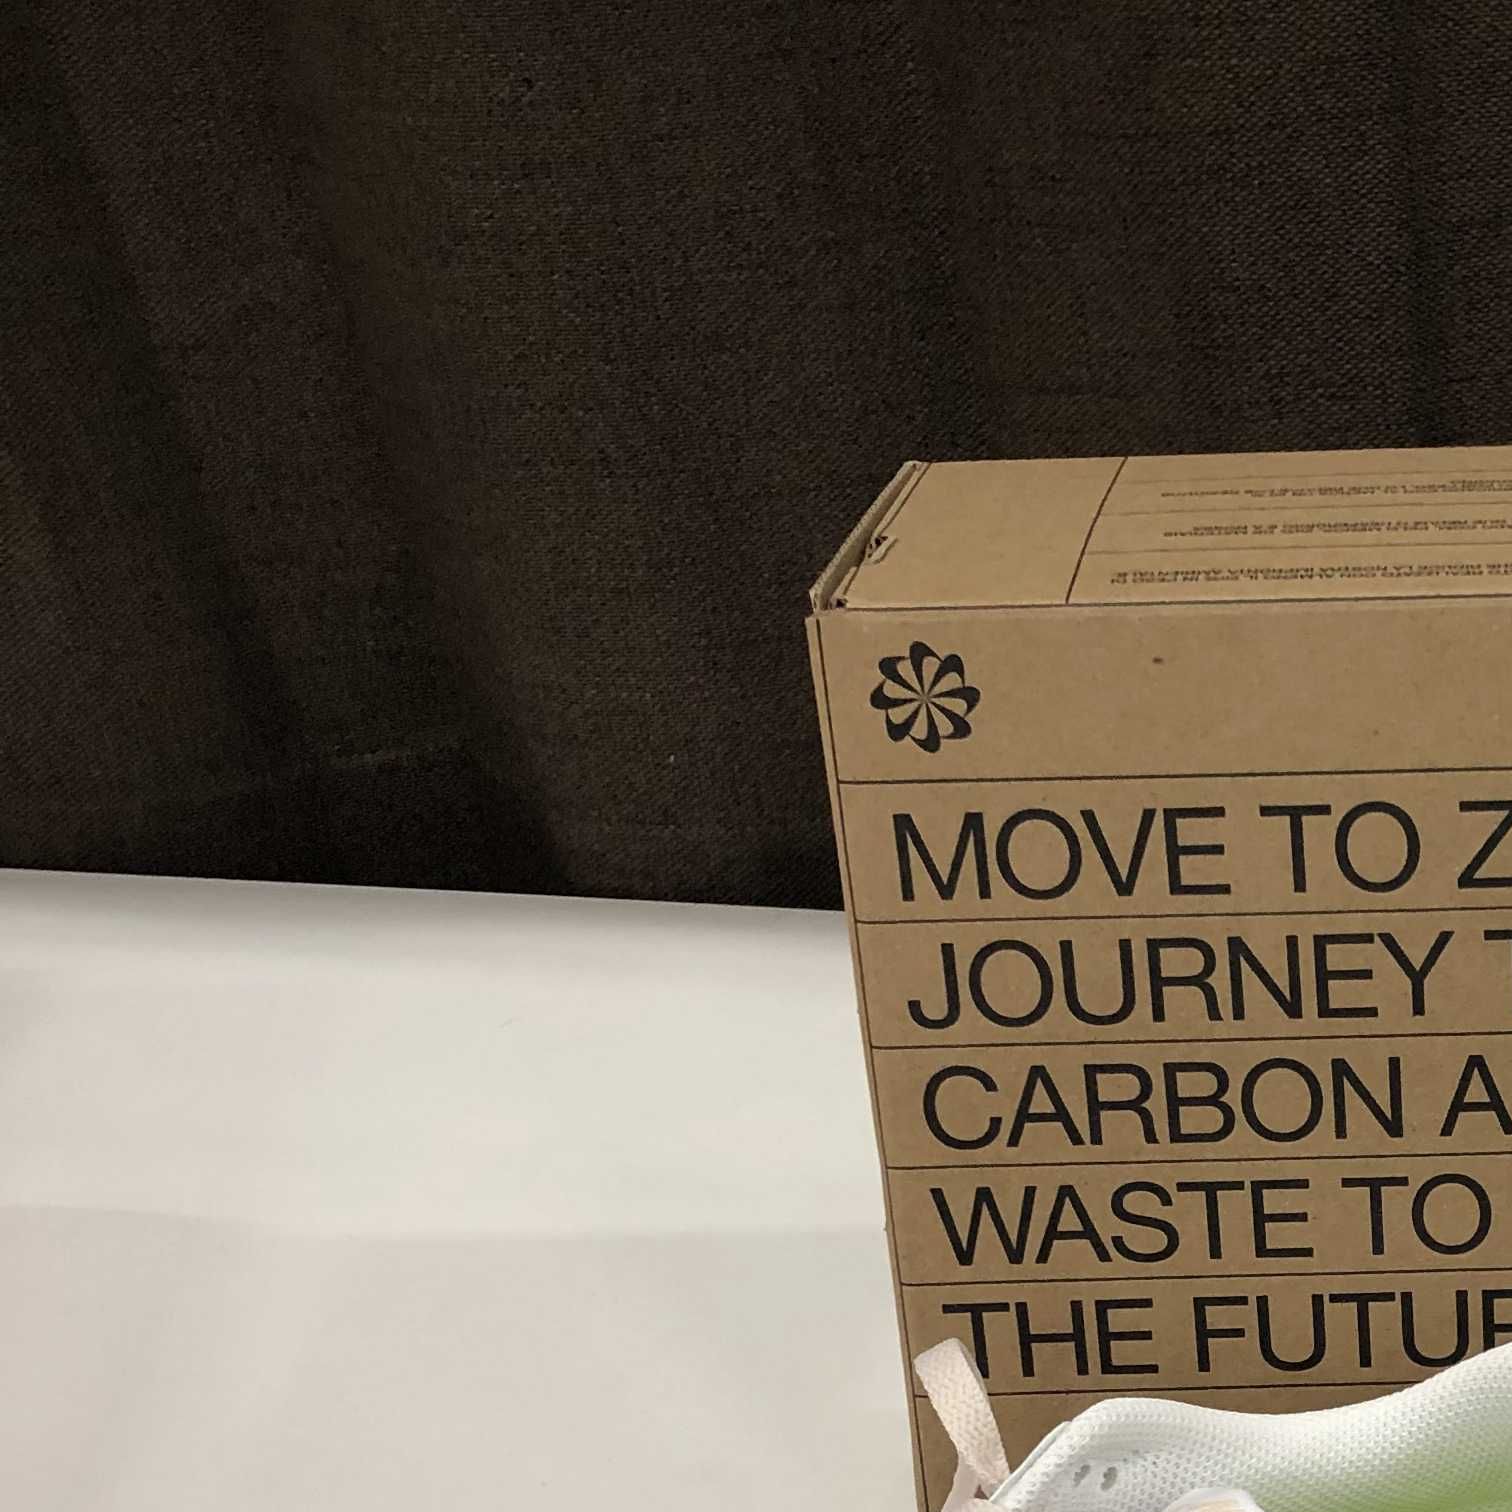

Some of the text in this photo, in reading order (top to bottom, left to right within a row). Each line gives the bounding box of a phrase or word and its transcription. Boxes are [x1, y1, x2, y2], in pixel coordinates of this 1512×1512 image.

[892, 806, 1231, 902] MOVE
[1260, 801, 1421, 893] TO
[907, 930, 1454, 1030] JOURNEY
[922, 1055, 1402, 1151] CARBON
[930, 1177, 1314, 1266] WASTE
[1341, 1173, 1492, 1256] TO
[941, 1299, 1160, 1379] THE
